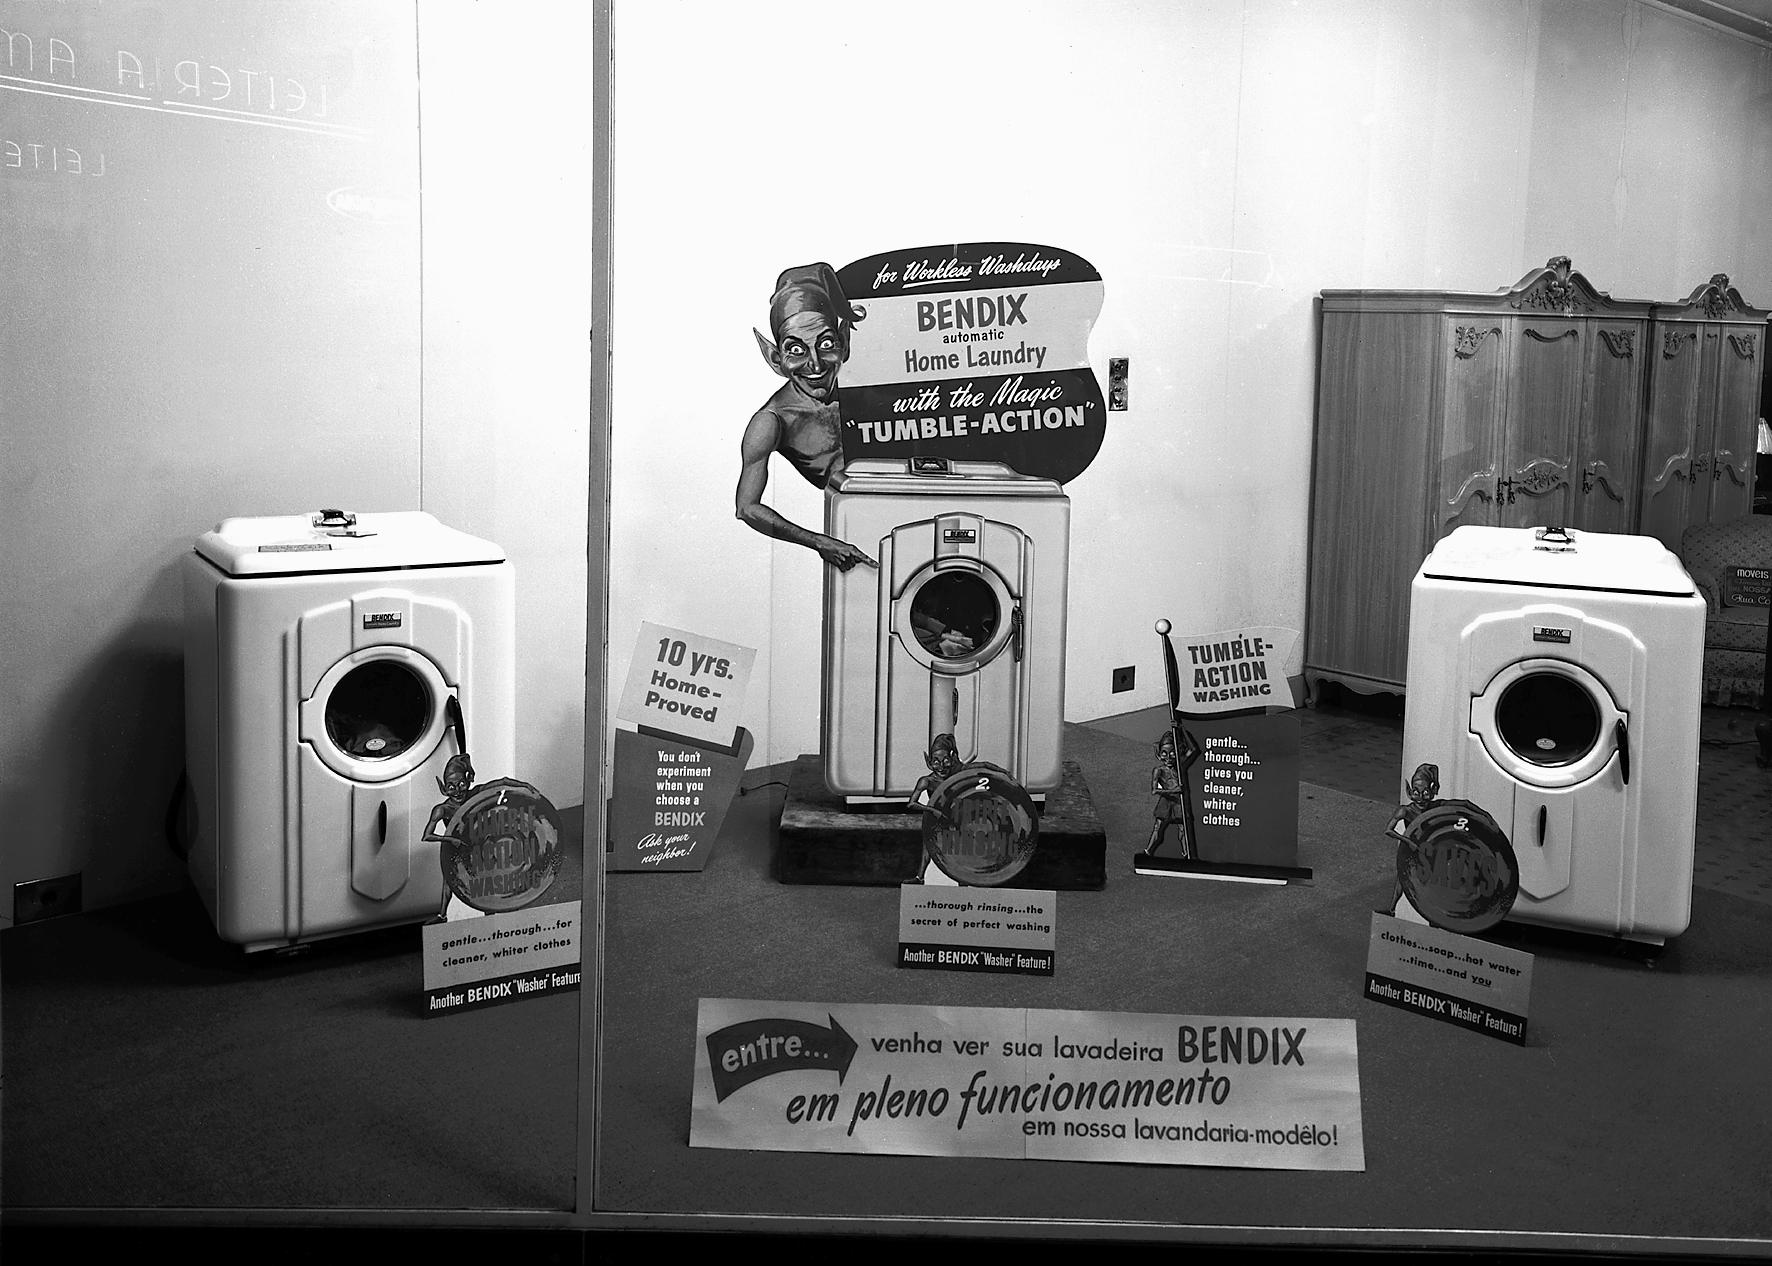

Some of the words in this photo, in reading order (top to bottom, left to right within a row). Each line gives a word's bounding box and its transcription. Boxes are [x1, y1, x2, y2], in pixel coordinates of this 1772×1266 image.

[872, 263, 898, 290] for
[902, 258, 973, 283] Workless
[979, 252, 1061, 278] Washdays
[916, 292, 1028, 332] BENDIX
[942, 329, 1005, 344] automatic
[904, 348, 960, 373] Home
[966, 341, 1047, 369] Laundry
[892, 385, 941, 413] with
[949, 382, 985, 408] the
[989, 375, 1063, 408] Magic
[656, 638, 687, 667] 10
[690, 651, 734, 680] yrs.
[1188, 637, 1274, 665] TUMBLE-
[650, 670, 722, 699] Home-
[1194, 660, 1268, 688] ACTION
[1192, 683, 1272, 703] WASHING
[644, 690, 718, 723] Proved
[1205, 736, 1248, 749] gentle...
[657, 750, 675, 763] You
[678, 750, 701, 763] don't
[1204, 751, 1261, 766] thorough...
[656, 766, 711, 779] experiment
[1204, 767, 1232, 780] gives
[1235, 769, 1253, 782] you
[656, 780, 683, 792] when
[686, 781, 704, 794] you
[975, 777, 991, 790] 2.
[1203, 782, 1244, 797] cleaner,
[496, 789, 508, 804] 1.
[655, 794, 691, 806] choose
[693, 797, 700, 806] a
[1203, 798, 1237, 811] whiter
[467, 805, 537, 842] TUMBLE
[654, 811, 706, 827] BENDIX
[1202, 813, 1241, 827] clothes
[1453, 817, 1470, 832] 3.
[637, 833, 663, 850] Ask
[665, 833, 691, 850] your
[470, 836, 537, 873] ACTION
[640, 841, 697, 866] neighbor!
[469, 869, 541, 898] WASHING
[911, 917, 941, 926] secret
[947, 917, 958, 927] of
[963, 919, 1000, 931] perfect
[1006, 921, 1050, 934] washing
[442, 951, 488, 968] cleaner,
[492, 943, 529, 960] whiter
[533, 937, 571, 954] clothes
[904, 948, 935, 963] Another
[938, 951, 979, 965] BENDIX
[1017, 952, 1051, 970] Feature!
[1488, 960, 1522, 977] water
[1471, 974, 1492, 987] you
[430, 991, 464, 1011] Another
[467, 981, 512, 1004] BENDIX
[1369, 979, 1401, 1001] Another
[1403, 988, 1448, 1014] BENDIX
[1485, 1012, 1523, 1037] Feature!
[721, 1032, 829, 1073] entre...
[871, 1031, 942, 1055] venha
[953, 1038, 990, 1056] ver
[1002, 1041, 1042, 1058] sua
[1053, 1035, 1164, 1062] lavadeira
[1178, 1024, 1307, 1067] BENDIX
[785, 1092, 840, 1125] em
[847, 1073, 949, 1137] pleno
[957, 1067, 1231, 1131] funcionamento
[1022, 1119, 1056, 1137] em
[1064, 1121, 1127, 1139] nossa
[1134, 1117, 1338, 1147] lavandaria-modêlo!
